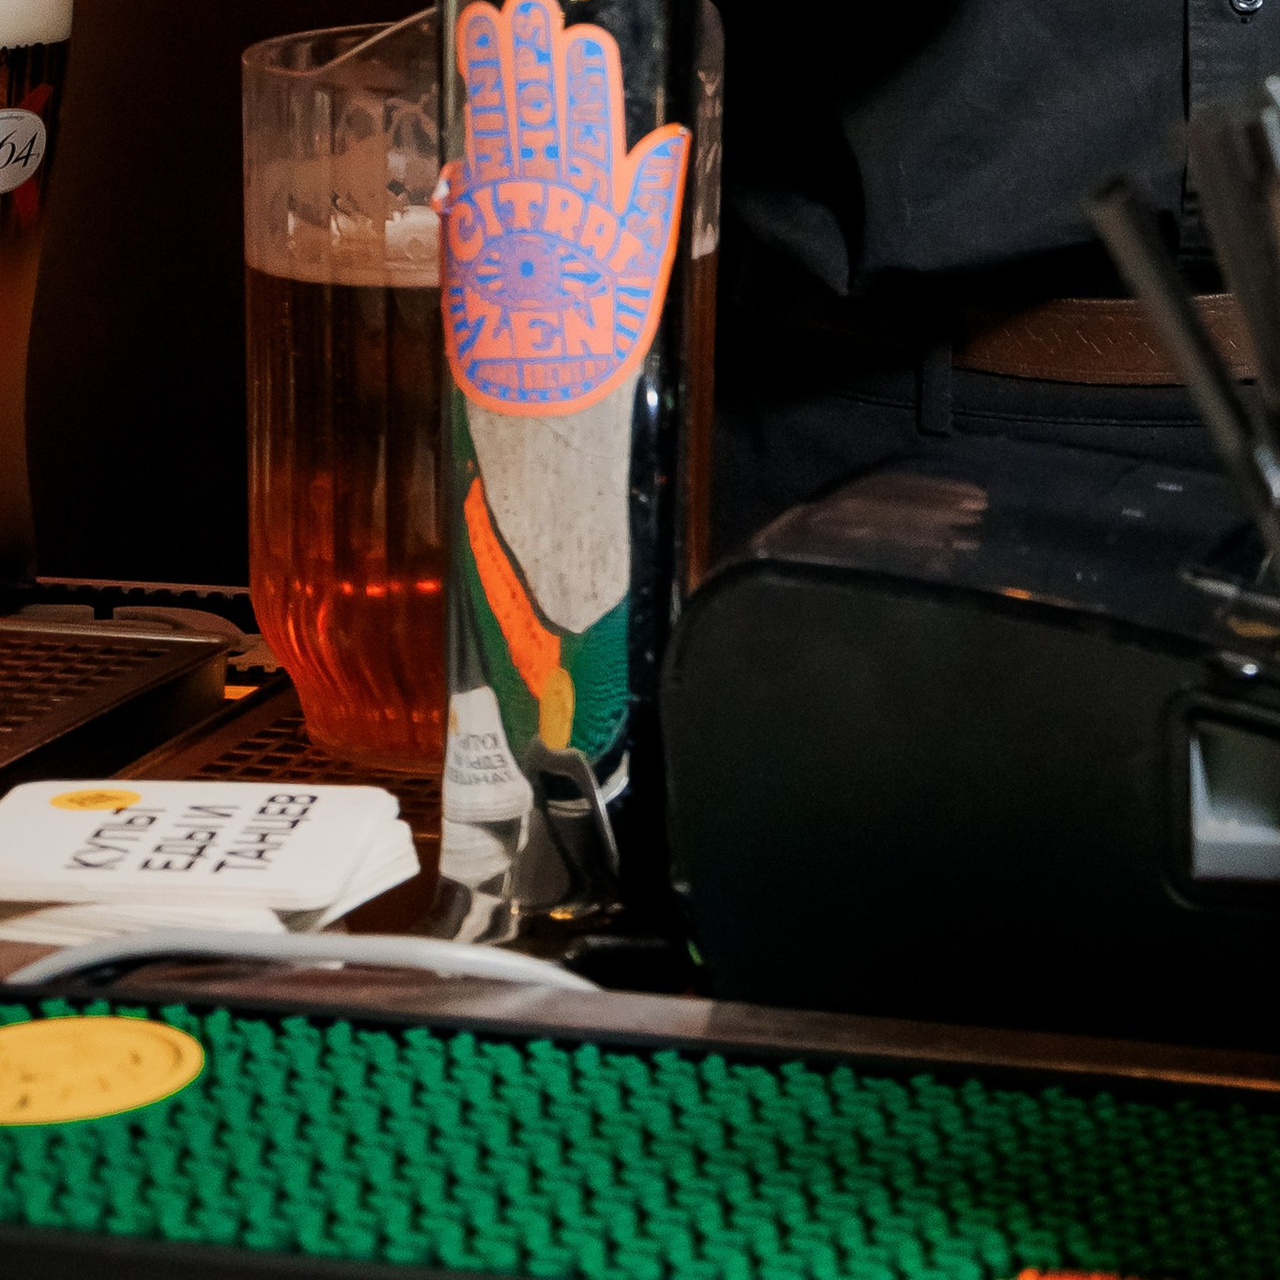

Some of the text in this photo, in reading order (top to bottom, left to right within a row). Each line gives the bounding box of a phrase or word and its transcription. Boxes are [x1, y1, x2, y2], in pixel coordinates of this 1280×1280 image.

[514, 8, 558, 179] HOPS
[465, 282, 615, 359] ZEN
[212, 793, 318, 873] ТАНЦЕВ
